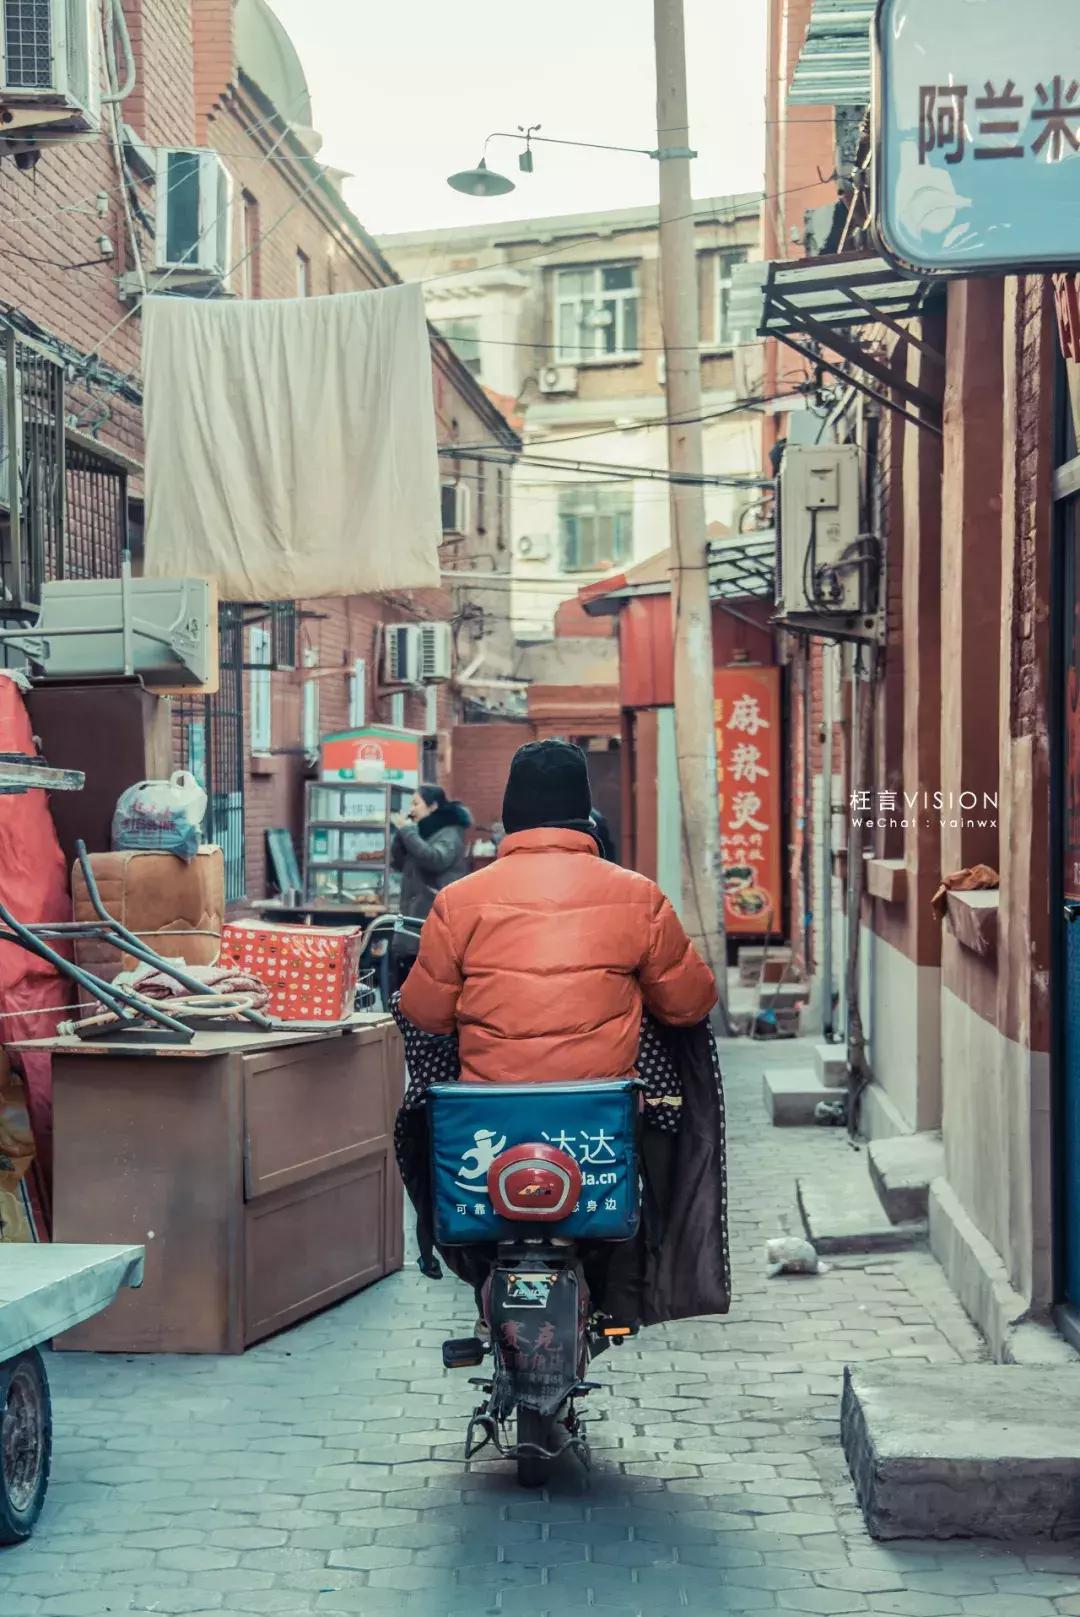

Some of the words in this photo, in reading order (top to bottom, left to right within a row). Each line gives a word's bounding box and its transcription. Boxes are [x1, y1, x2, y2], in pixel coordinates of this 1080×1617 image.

[918, 75, 1080, 165] 阿兰米
[726, 694, 769, 831] 麻辣烫
